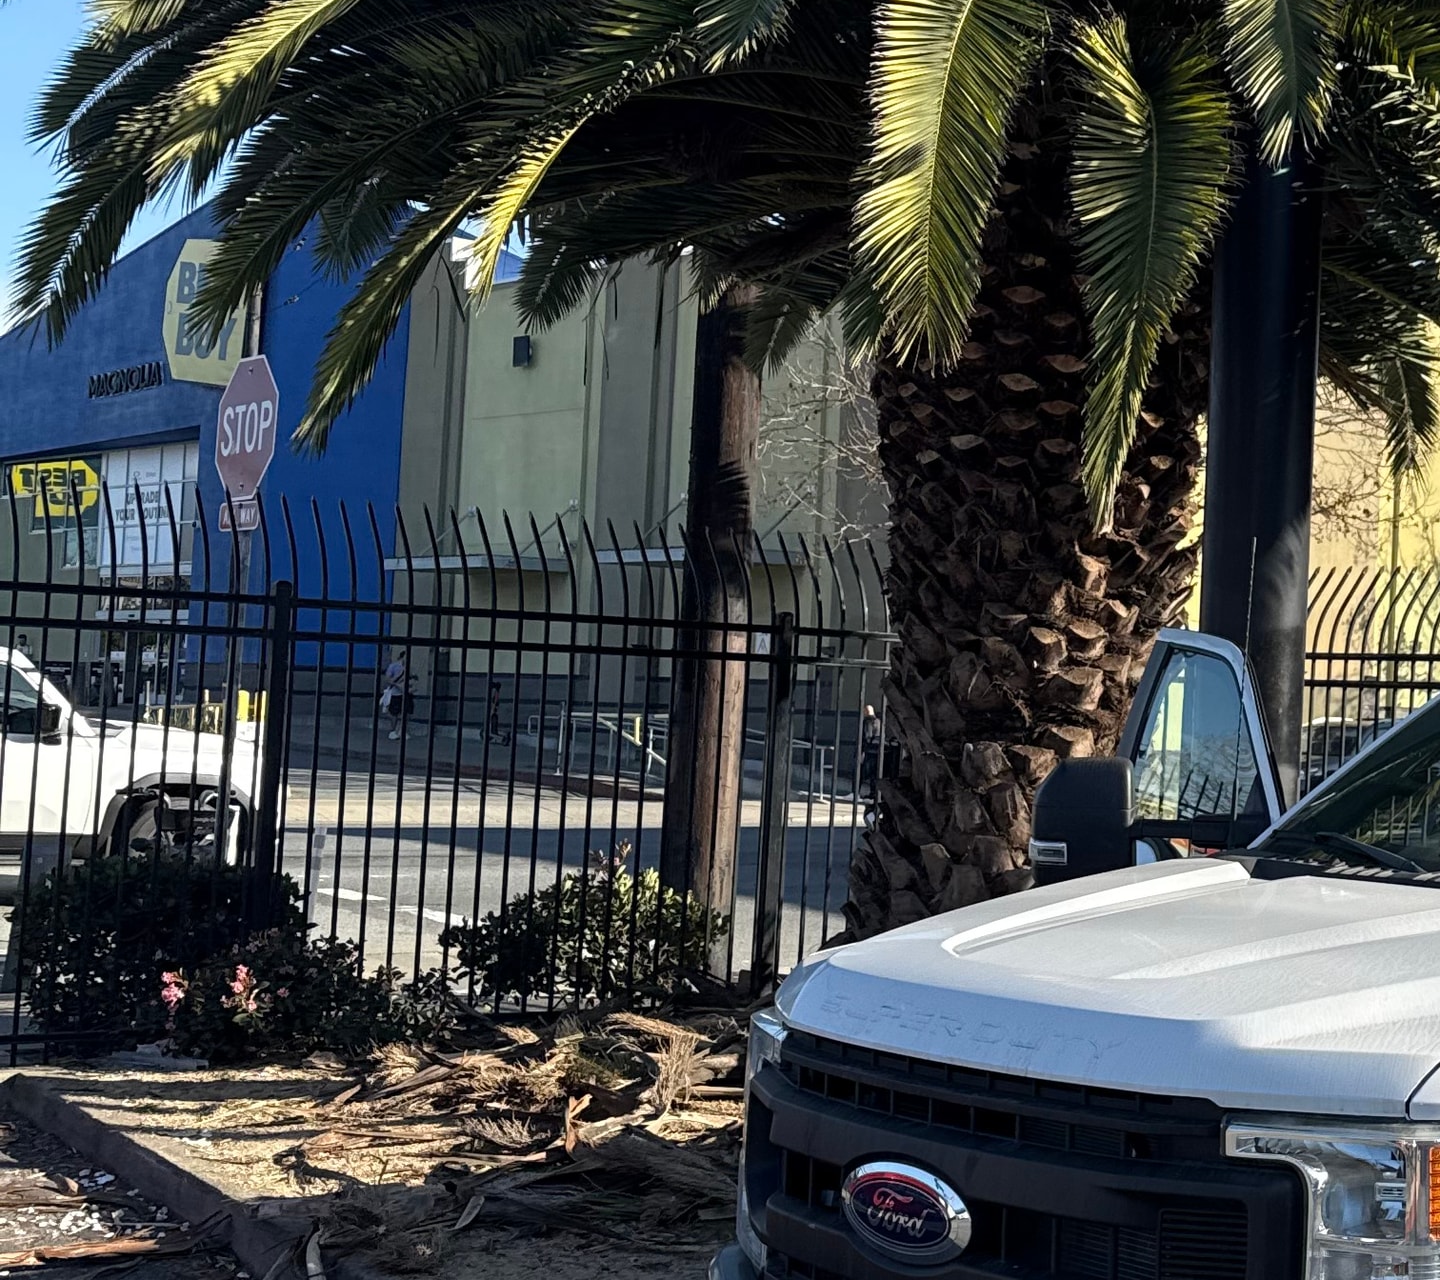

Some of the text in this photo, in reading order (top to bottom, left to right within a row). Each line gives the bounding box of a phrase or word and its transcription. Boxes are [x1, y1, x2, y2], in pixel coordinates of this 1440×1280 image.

[88, 362, 164, 399] MAGNOLIA
[220, 400, 273, 457] STOP
[126, 491, 160, 505] UPRADE
[240, 507, 256, 523] WAY
[867, 1187, 938, 1238] Ford
